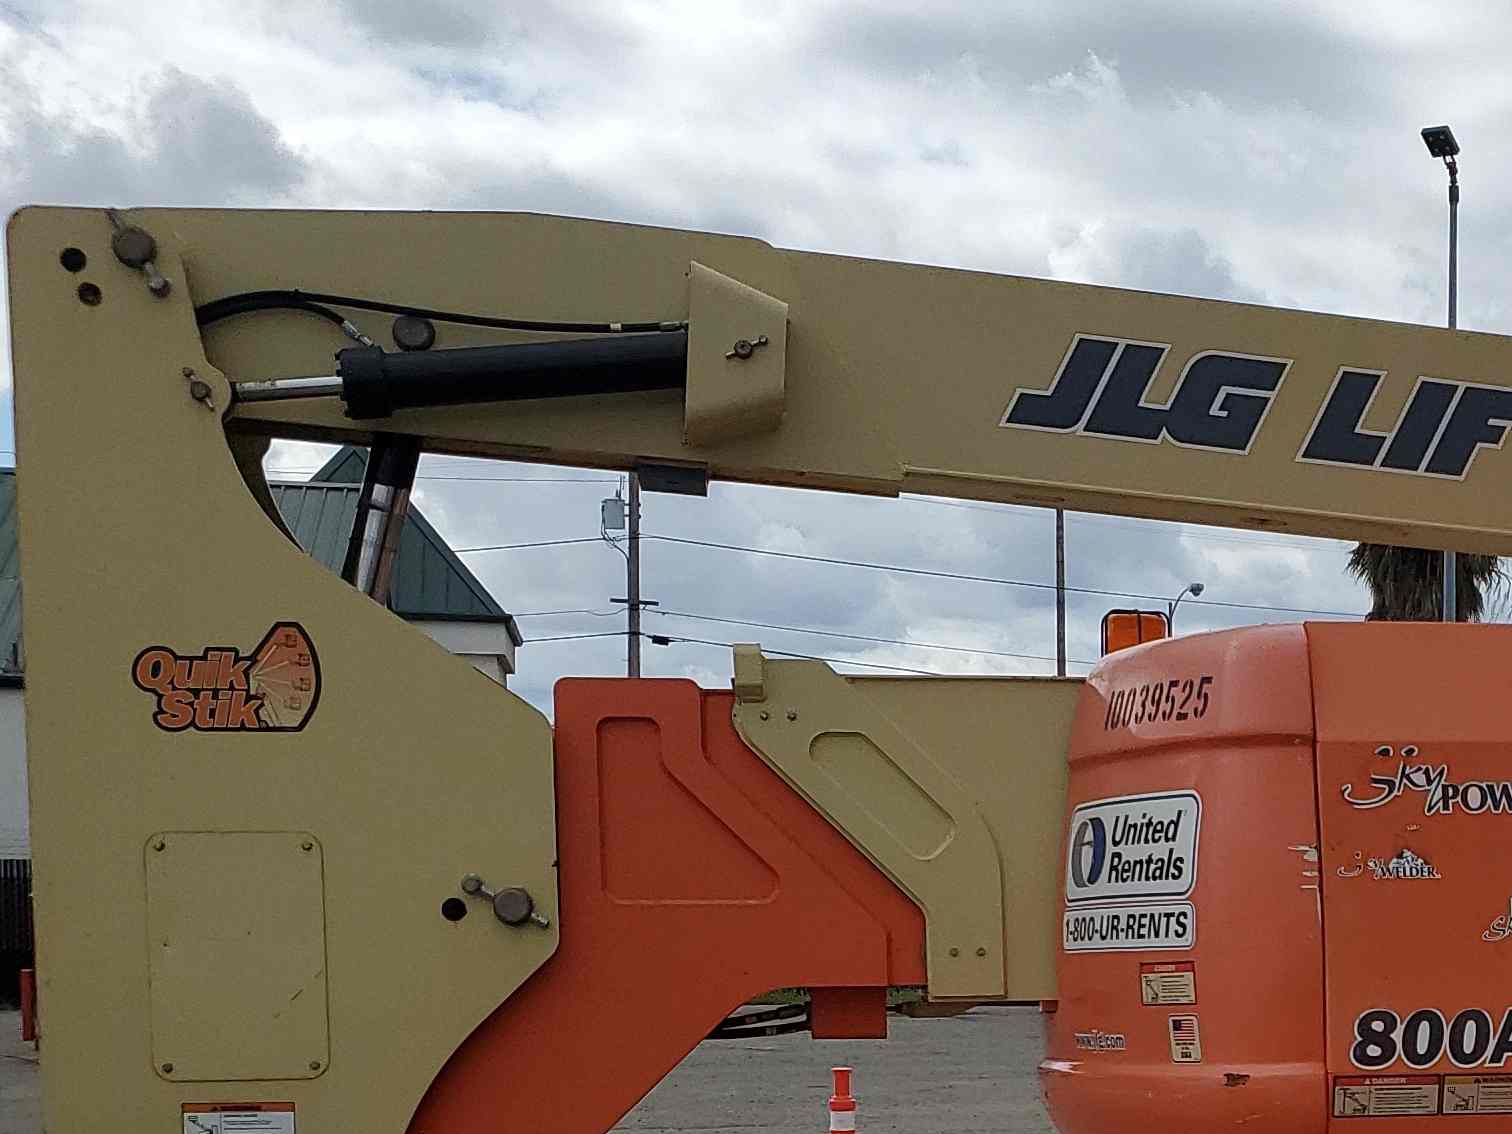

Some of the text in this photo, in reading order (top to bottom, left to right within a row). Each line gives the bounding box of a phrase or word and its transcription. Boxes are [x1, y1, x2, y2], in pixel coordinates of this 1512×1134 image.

[1000, 333, 1294, 456] JLG
[137, 650, 251, 695] Quik
[158, 689, 262, 728] Stik
[1103, 676, 1214, 731] 10039525
[1111, 809, 1183, 848] United
[1106, 848, 1185, 884] Rentals
[1065, 911, 1189, 943] 1-800-UR-RENTS
